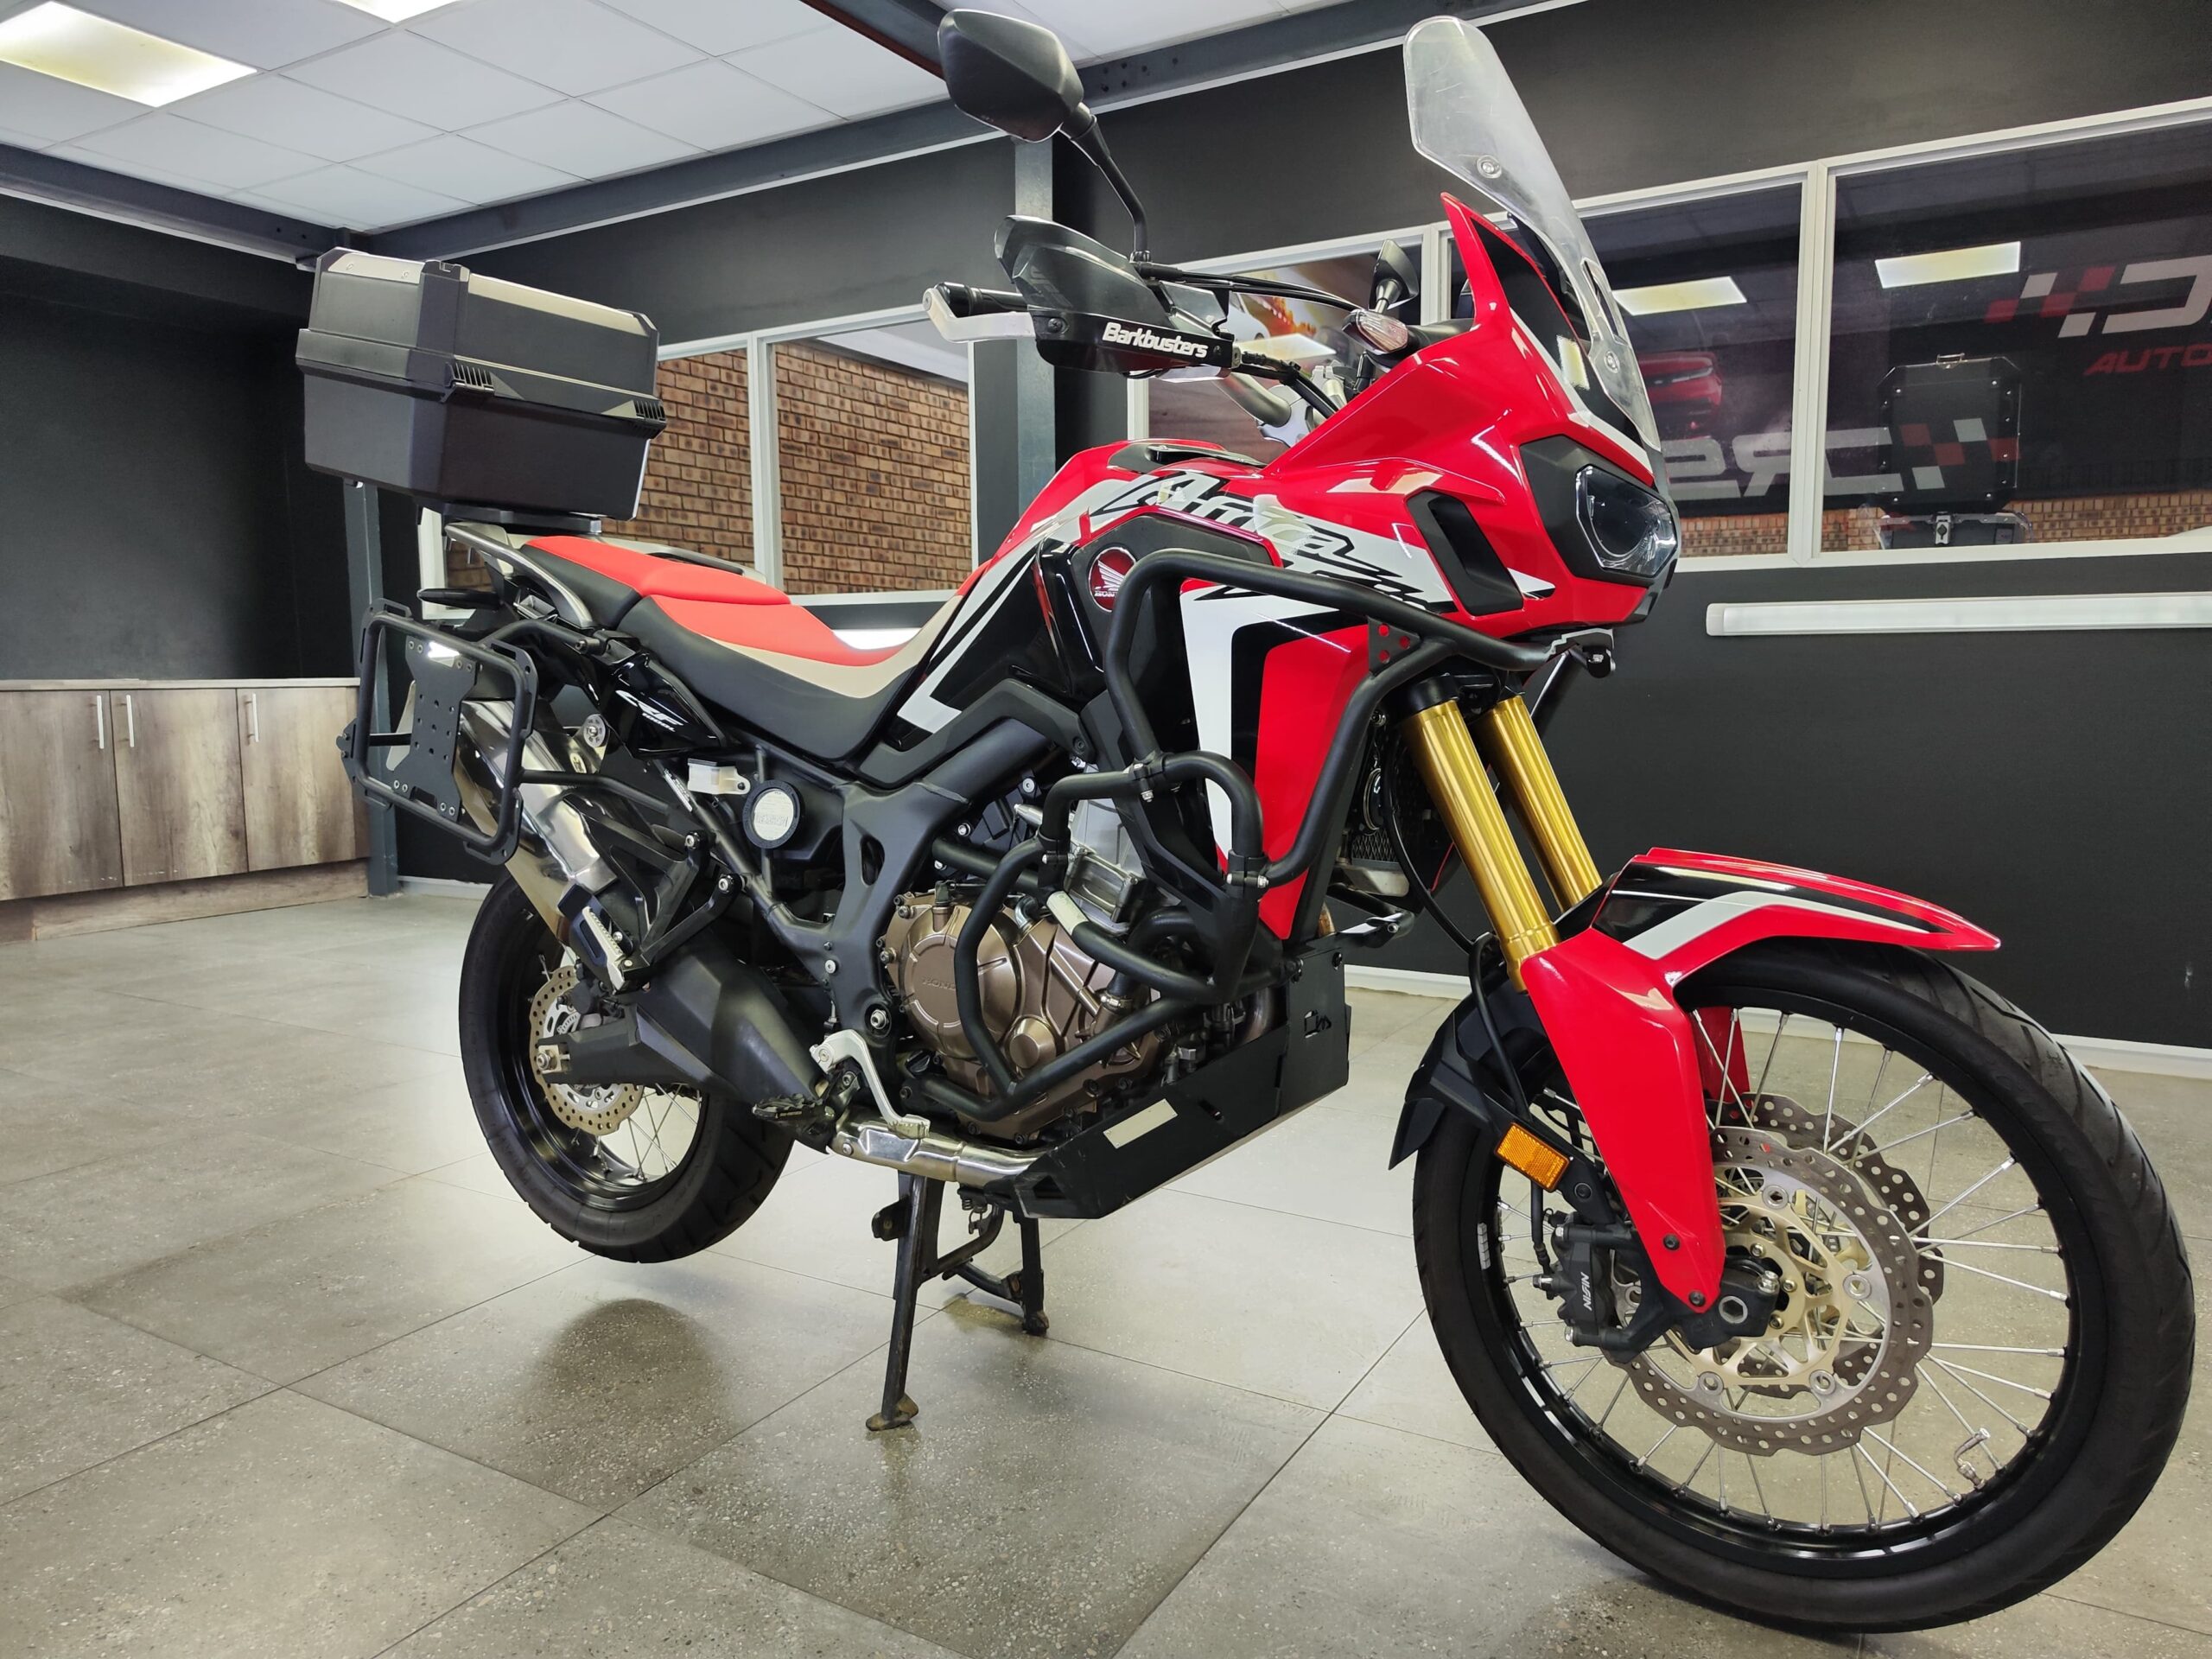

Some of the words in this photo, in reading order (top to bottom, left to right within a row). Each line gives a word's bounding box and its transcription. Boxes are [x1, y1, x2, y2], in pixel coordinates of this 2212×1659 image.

[1103, 321, 1209, 358] Barkbusters
[615, 690, 684, 726] CRF
[921, 976, 956, 990] HOND
